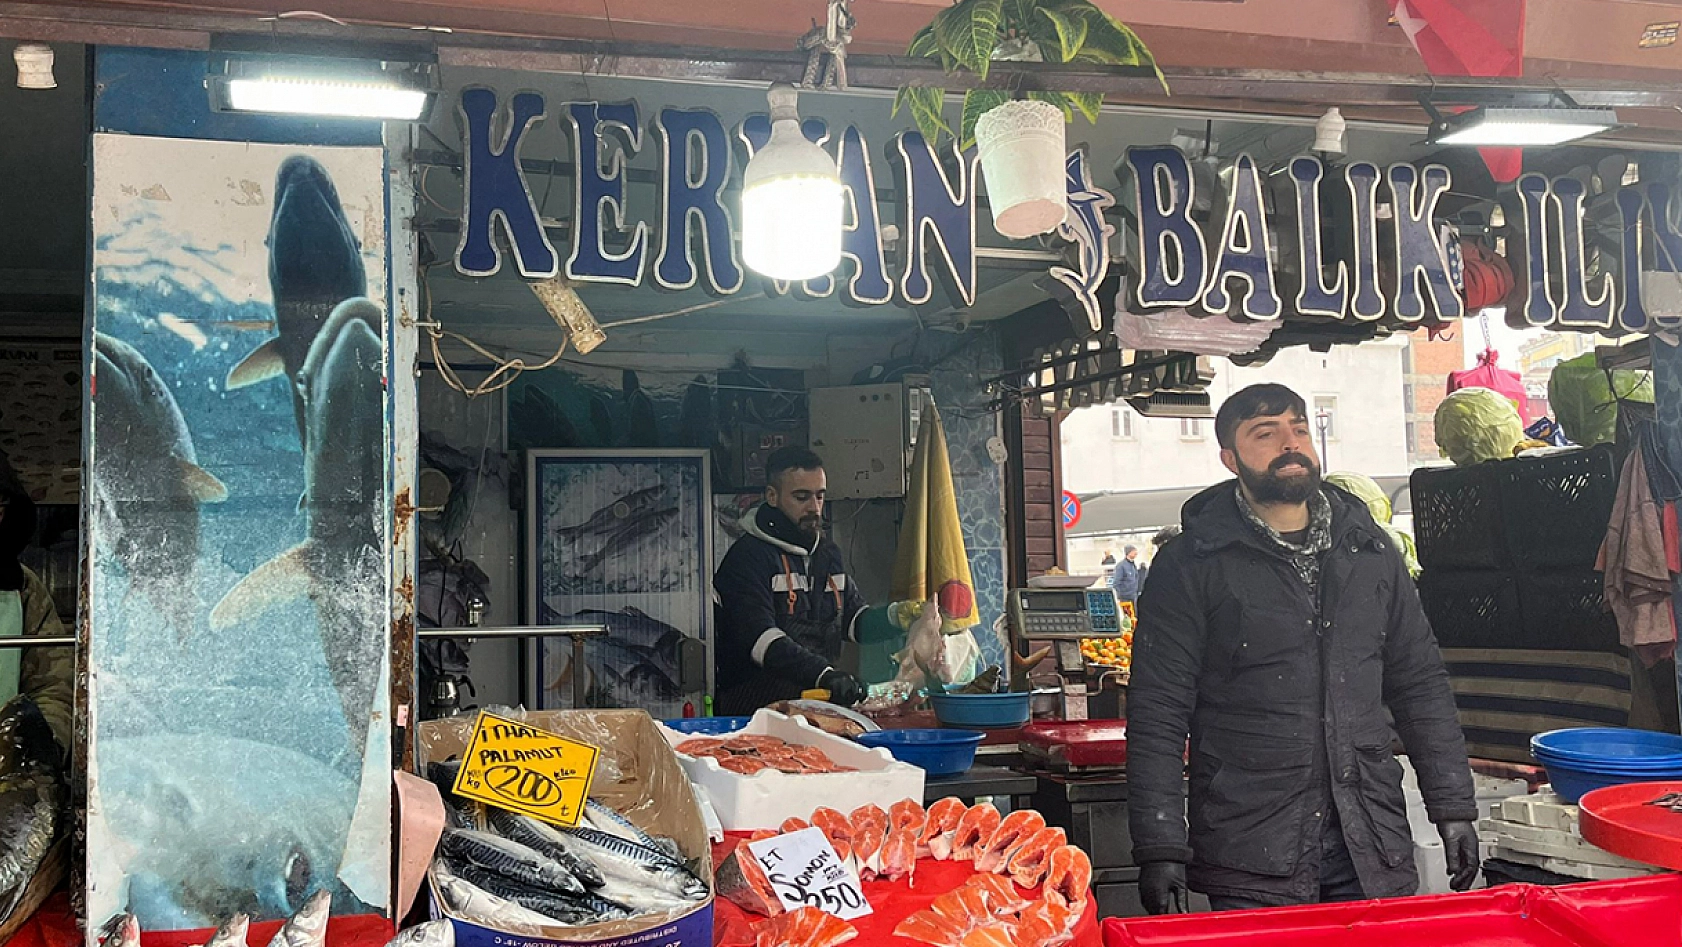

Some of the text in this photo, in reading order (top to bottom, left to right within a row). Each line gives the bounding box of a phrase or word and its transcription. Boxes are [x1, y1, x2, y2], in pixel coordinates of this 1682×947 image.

[455, 89, 982, 307] KERAN
[1126, 145, 1464, 321] BALIK
[478, 746, 563, 766] PALAMUT
[495, 766, 553, 801] 200
[759, 848, 783, 871] ET
[768, 850, 831, 902] SOMON
